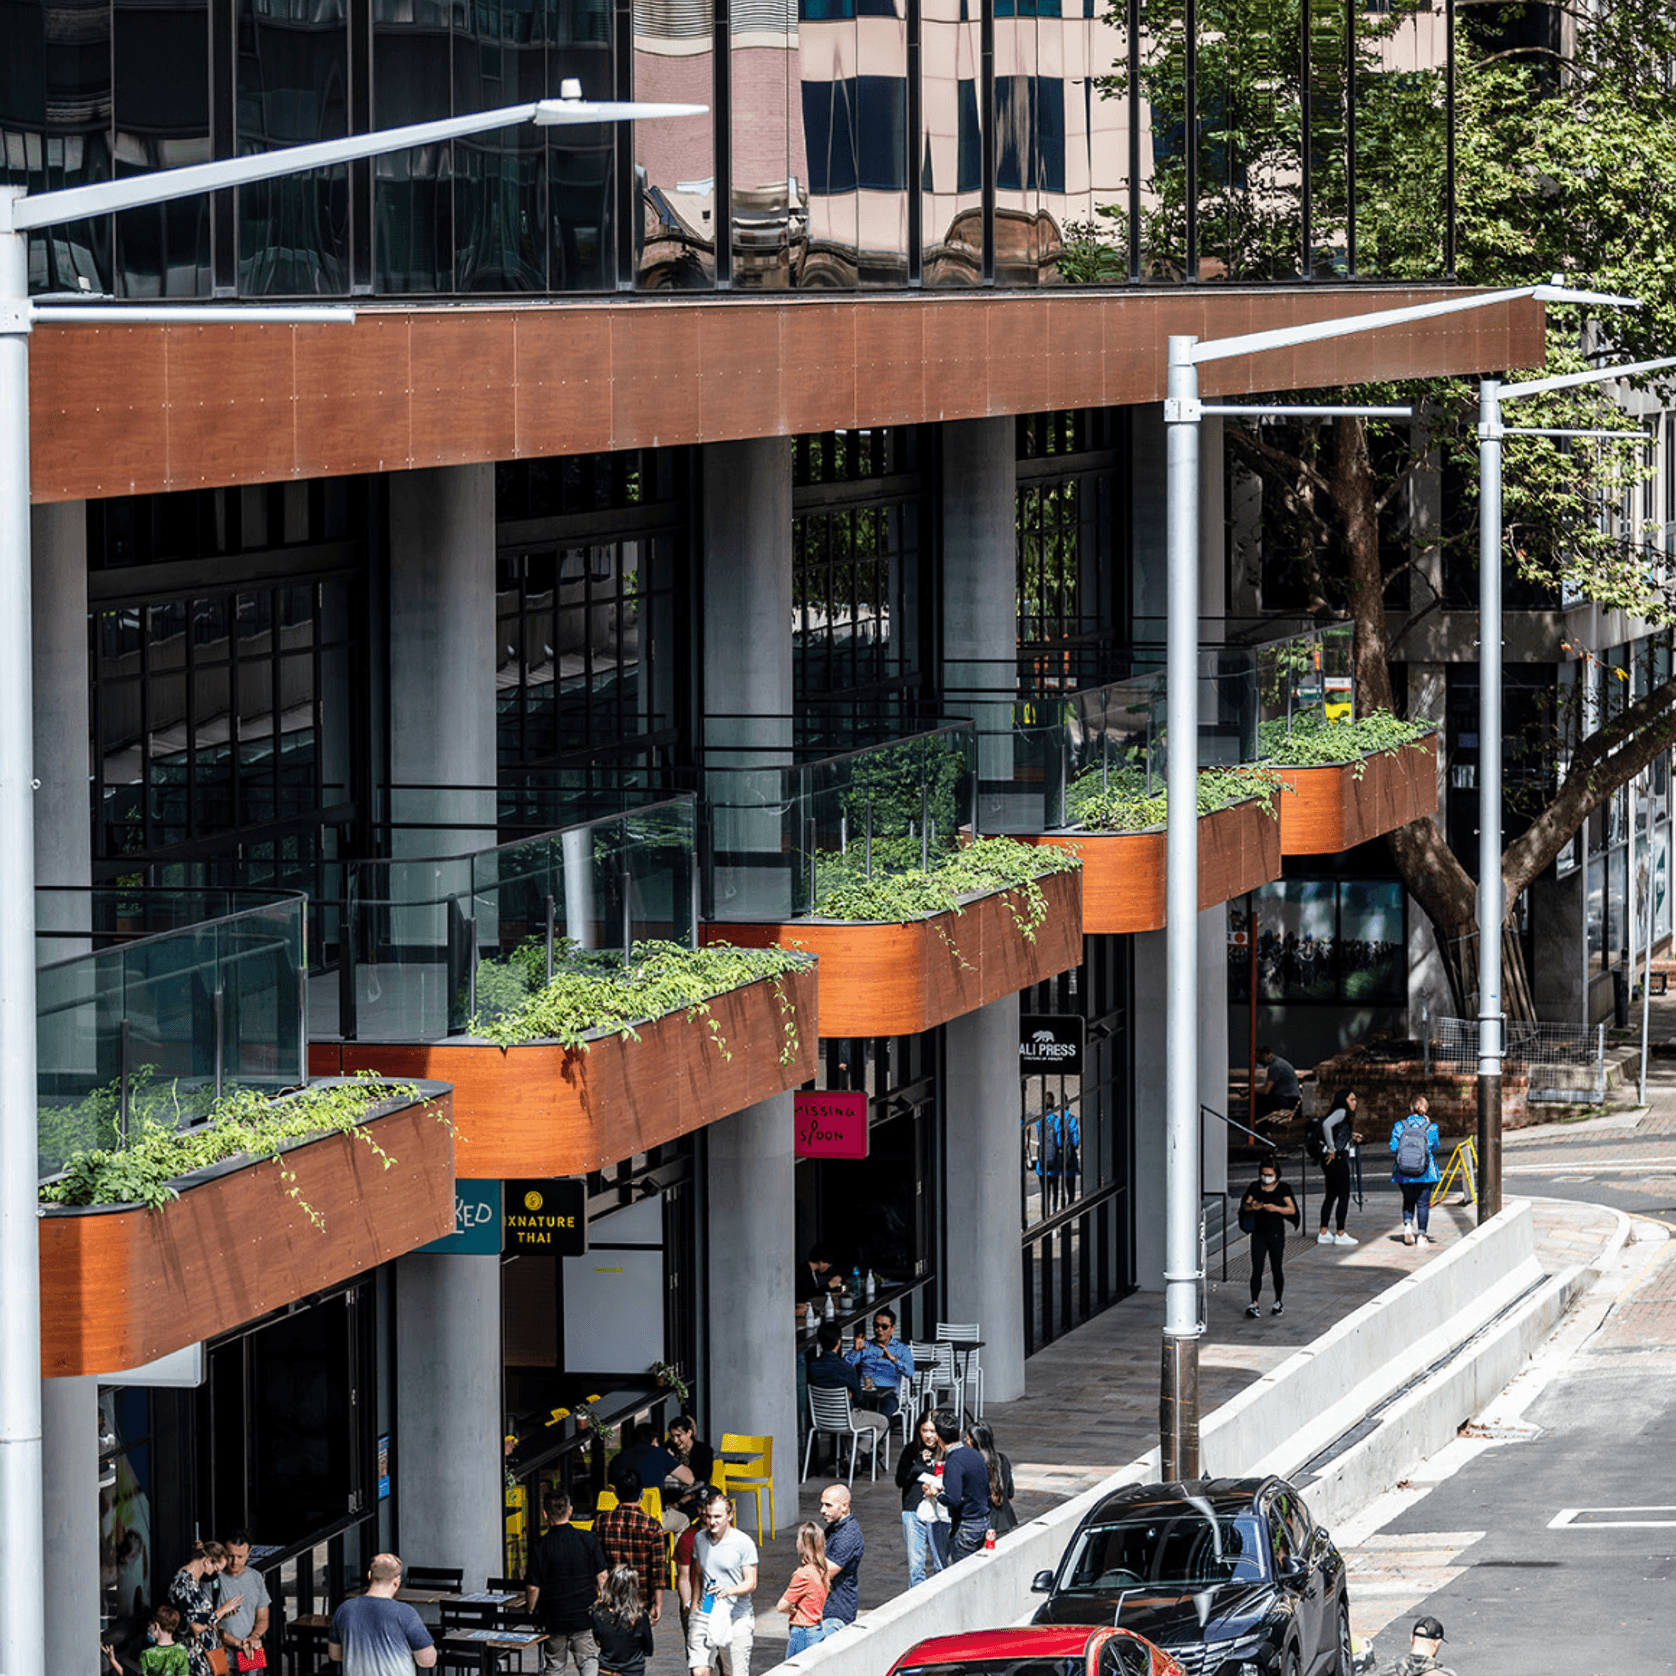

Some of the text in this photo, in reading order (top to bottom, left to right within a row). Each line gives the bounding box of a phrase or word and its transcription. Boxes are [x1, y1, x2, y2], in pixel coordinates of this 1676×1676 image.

[1019, 1043, 1077, 1057] ALI PRESS
[800, 1119, 844, 1147] SPOON
[516, 1231, 552, 1244] THAI
